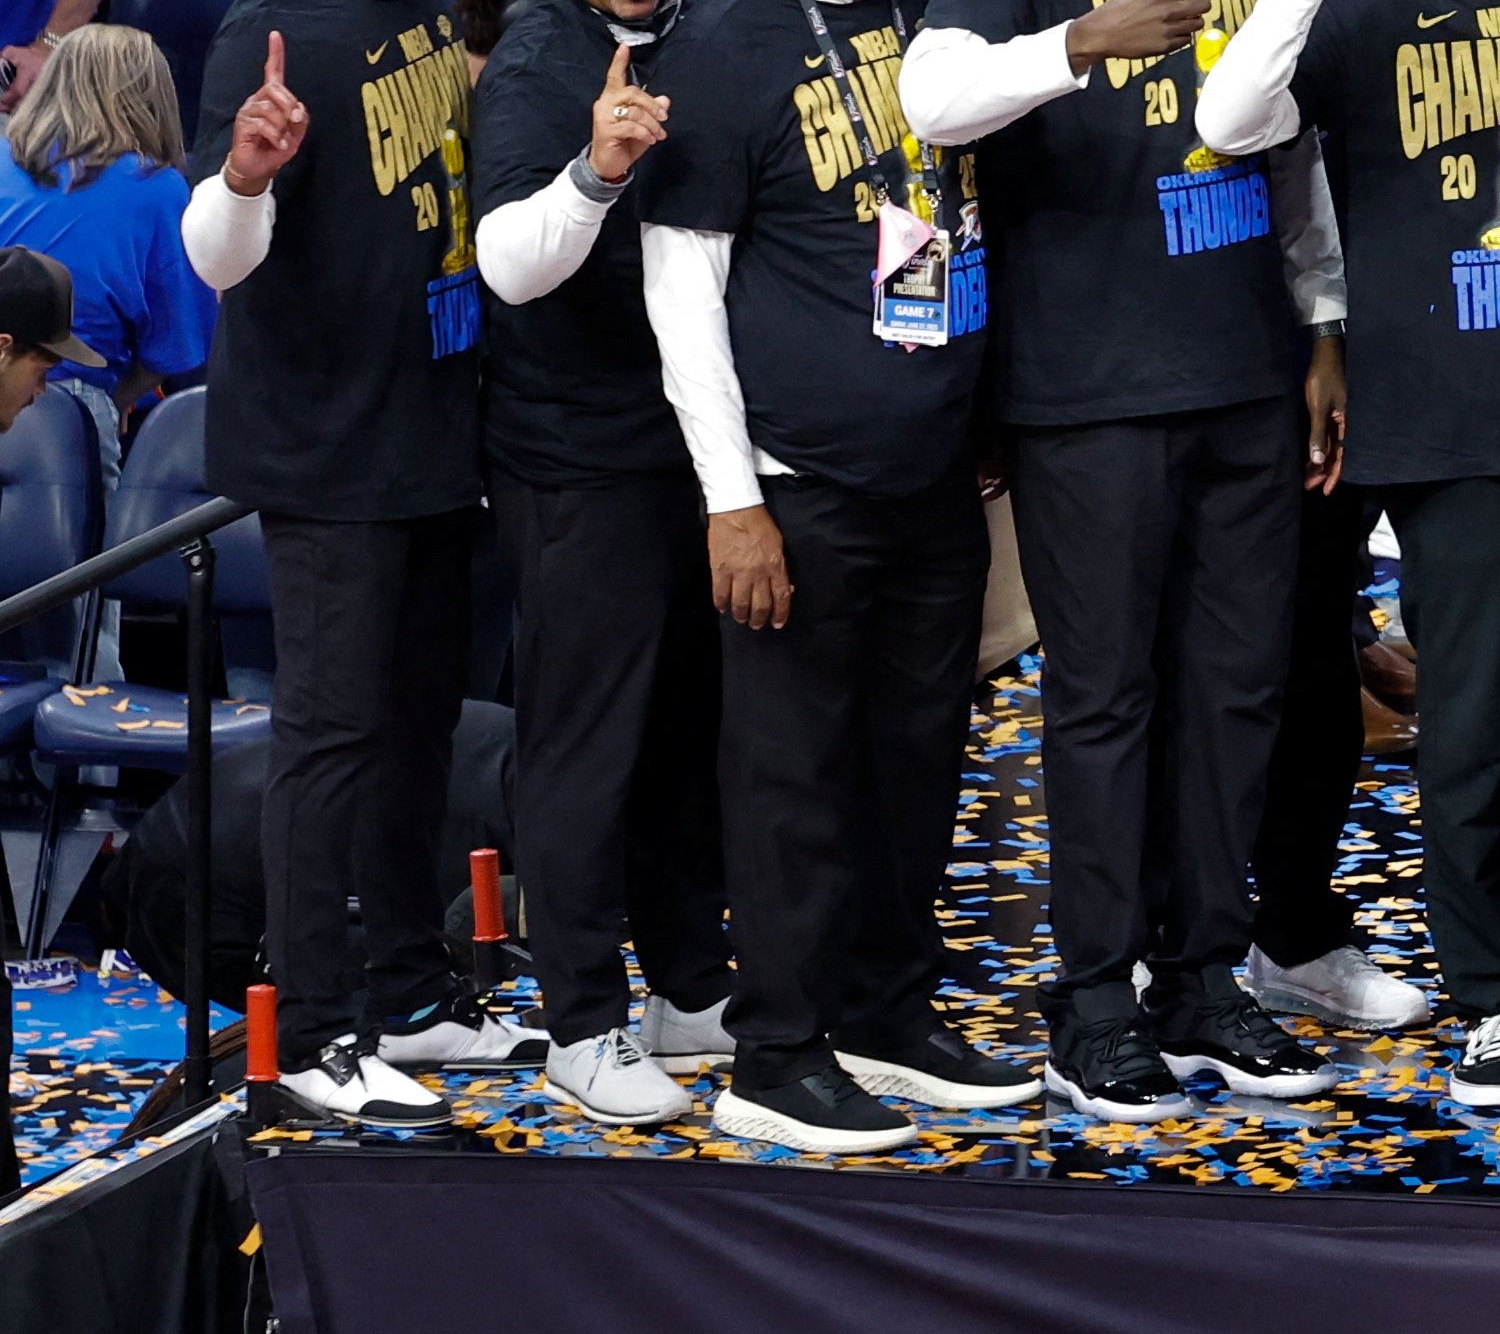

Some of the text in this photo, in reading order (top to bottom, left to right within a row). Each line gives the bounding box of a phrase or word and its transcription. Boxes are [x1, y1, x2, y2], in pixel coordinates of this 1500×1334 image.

[397, 24, 433, 62] NBA
[849, 26, 902, 60] NBA
[1145, 79, 1178, 126] 20
[1440, 155, 1476, 200] 20
[412, 184, 438, 232] 20
[894, 305, 934, 317] GAME 7
